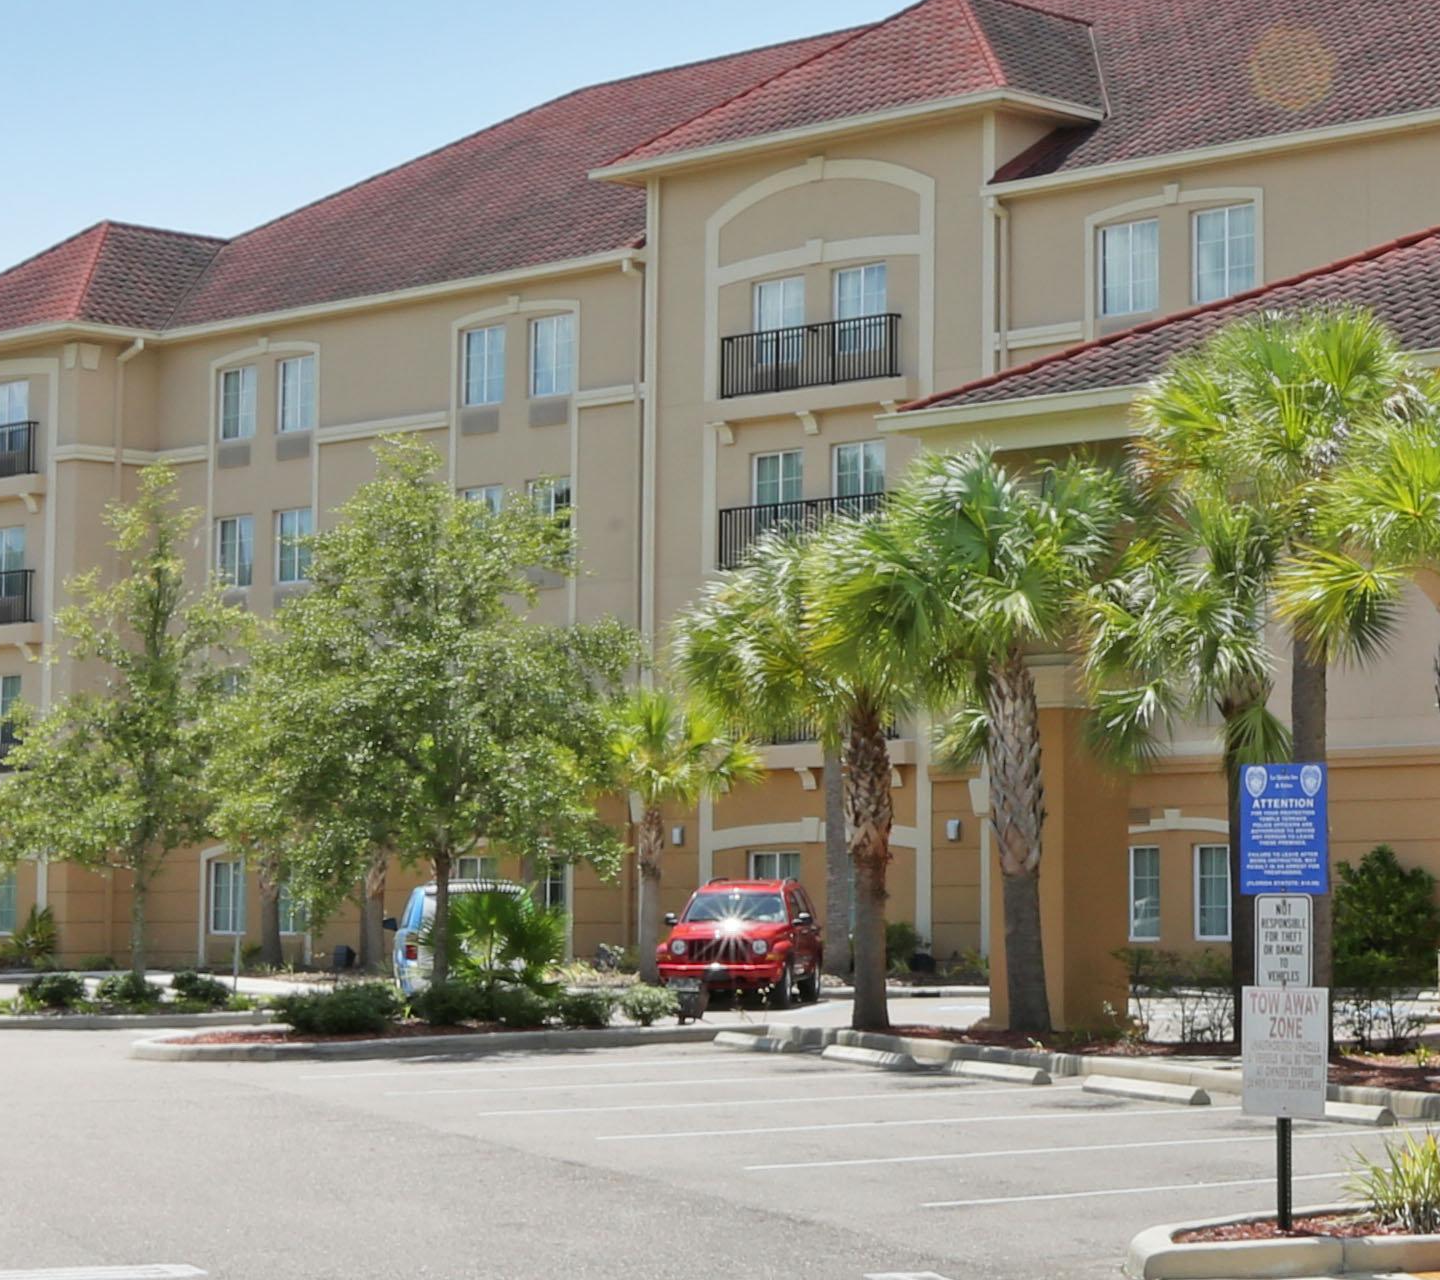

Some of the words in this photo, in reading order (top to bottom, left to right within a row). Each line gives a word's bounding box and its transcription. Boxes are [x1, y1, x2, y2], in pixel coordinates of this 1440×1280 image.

[1252, 799, 1314, 809] ATTENTION
[1276, 904, 1291, 916] NOT
[1261, 918, 1306, 929] RESPONSIBLE
[1264, 931, 1278, 942] FOR
[1281, 931, 1302, 942] THEFT
[1263, 944, 1273, 955] OR
[1276, 944, 1303, 955] DAMAGE
[1279, 958, 1288, 968] TO
[1268, 971, 1299, 982] VEHICLES
[1250, 992, 1280, 1014] TOW
[1284, 993, 1320, 1016] AWAY
[1269, 1017, 1303, 1039] ZONE
